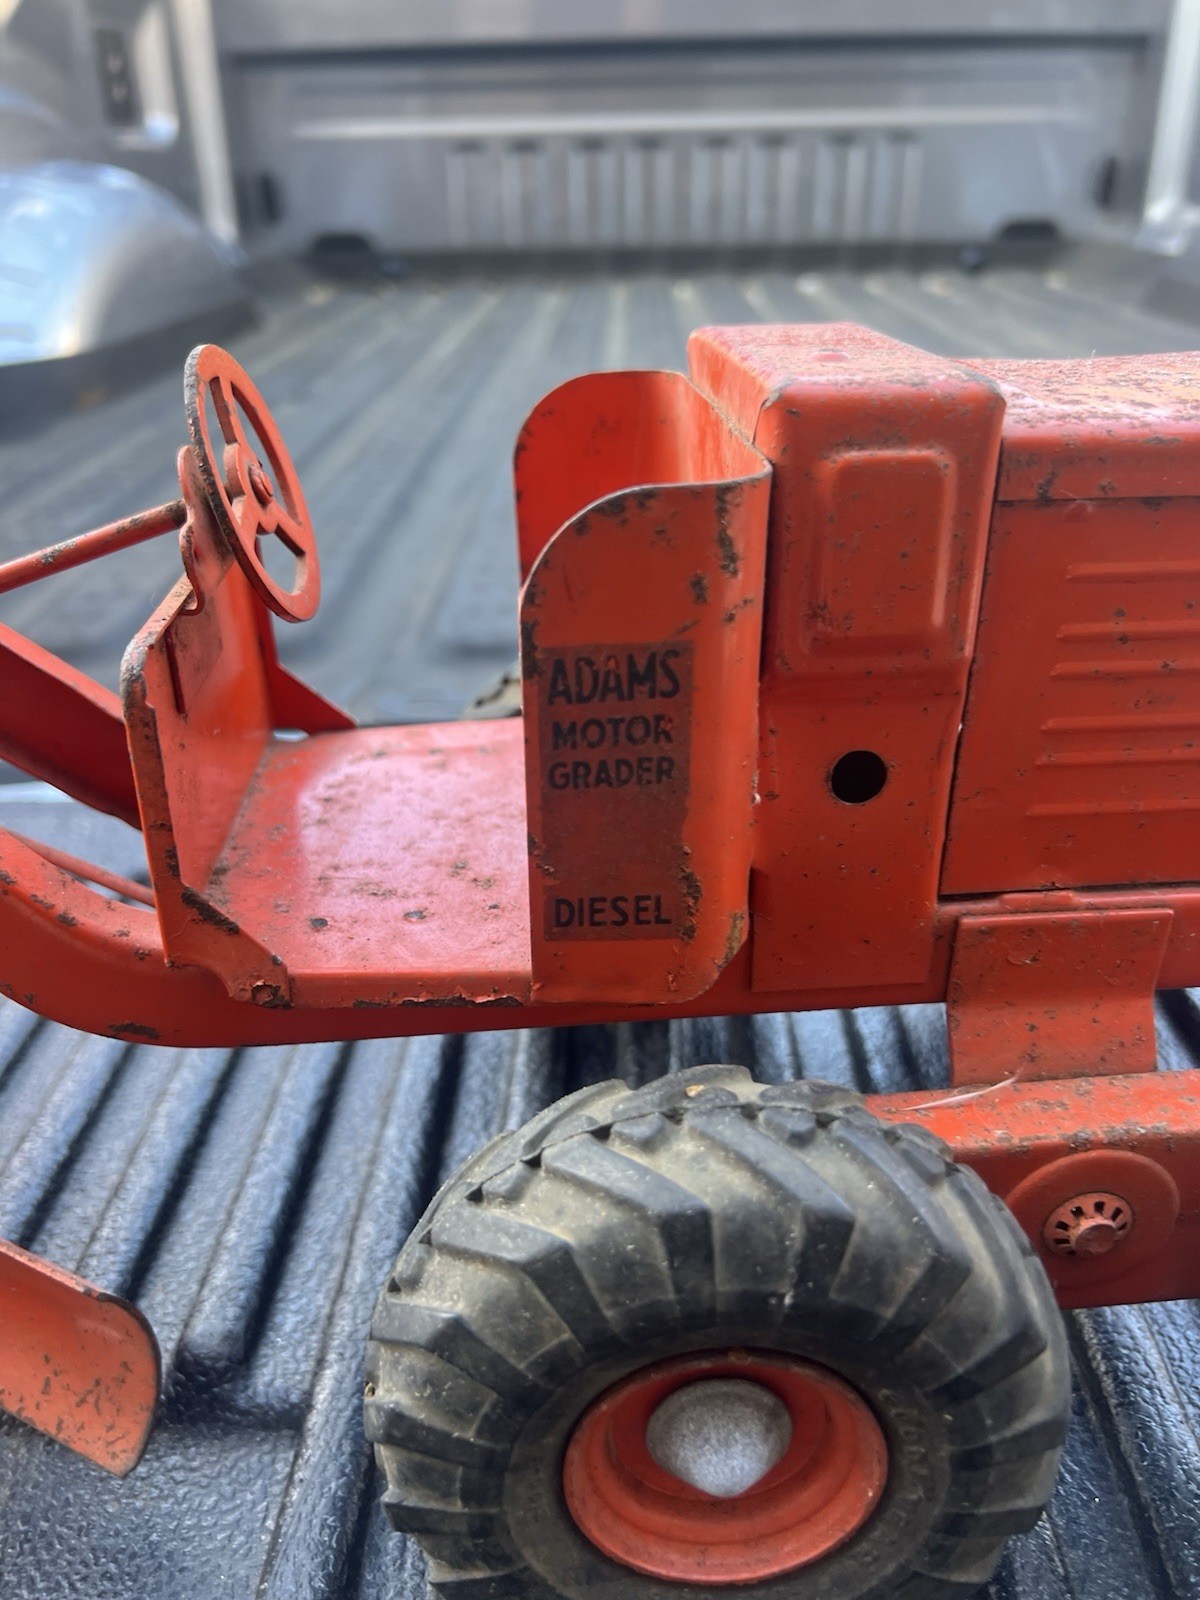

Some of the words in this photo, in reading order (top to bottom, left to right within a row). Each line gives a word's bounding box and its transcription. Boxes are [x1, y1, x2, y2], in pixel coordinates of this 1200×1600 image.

[547, 650, 680, 706] ADAMS
[551, 715, 673, 751] MOTOR
[547, 756, 676, 790] GRADER
[553, 895, 672, 928] DIESEL
